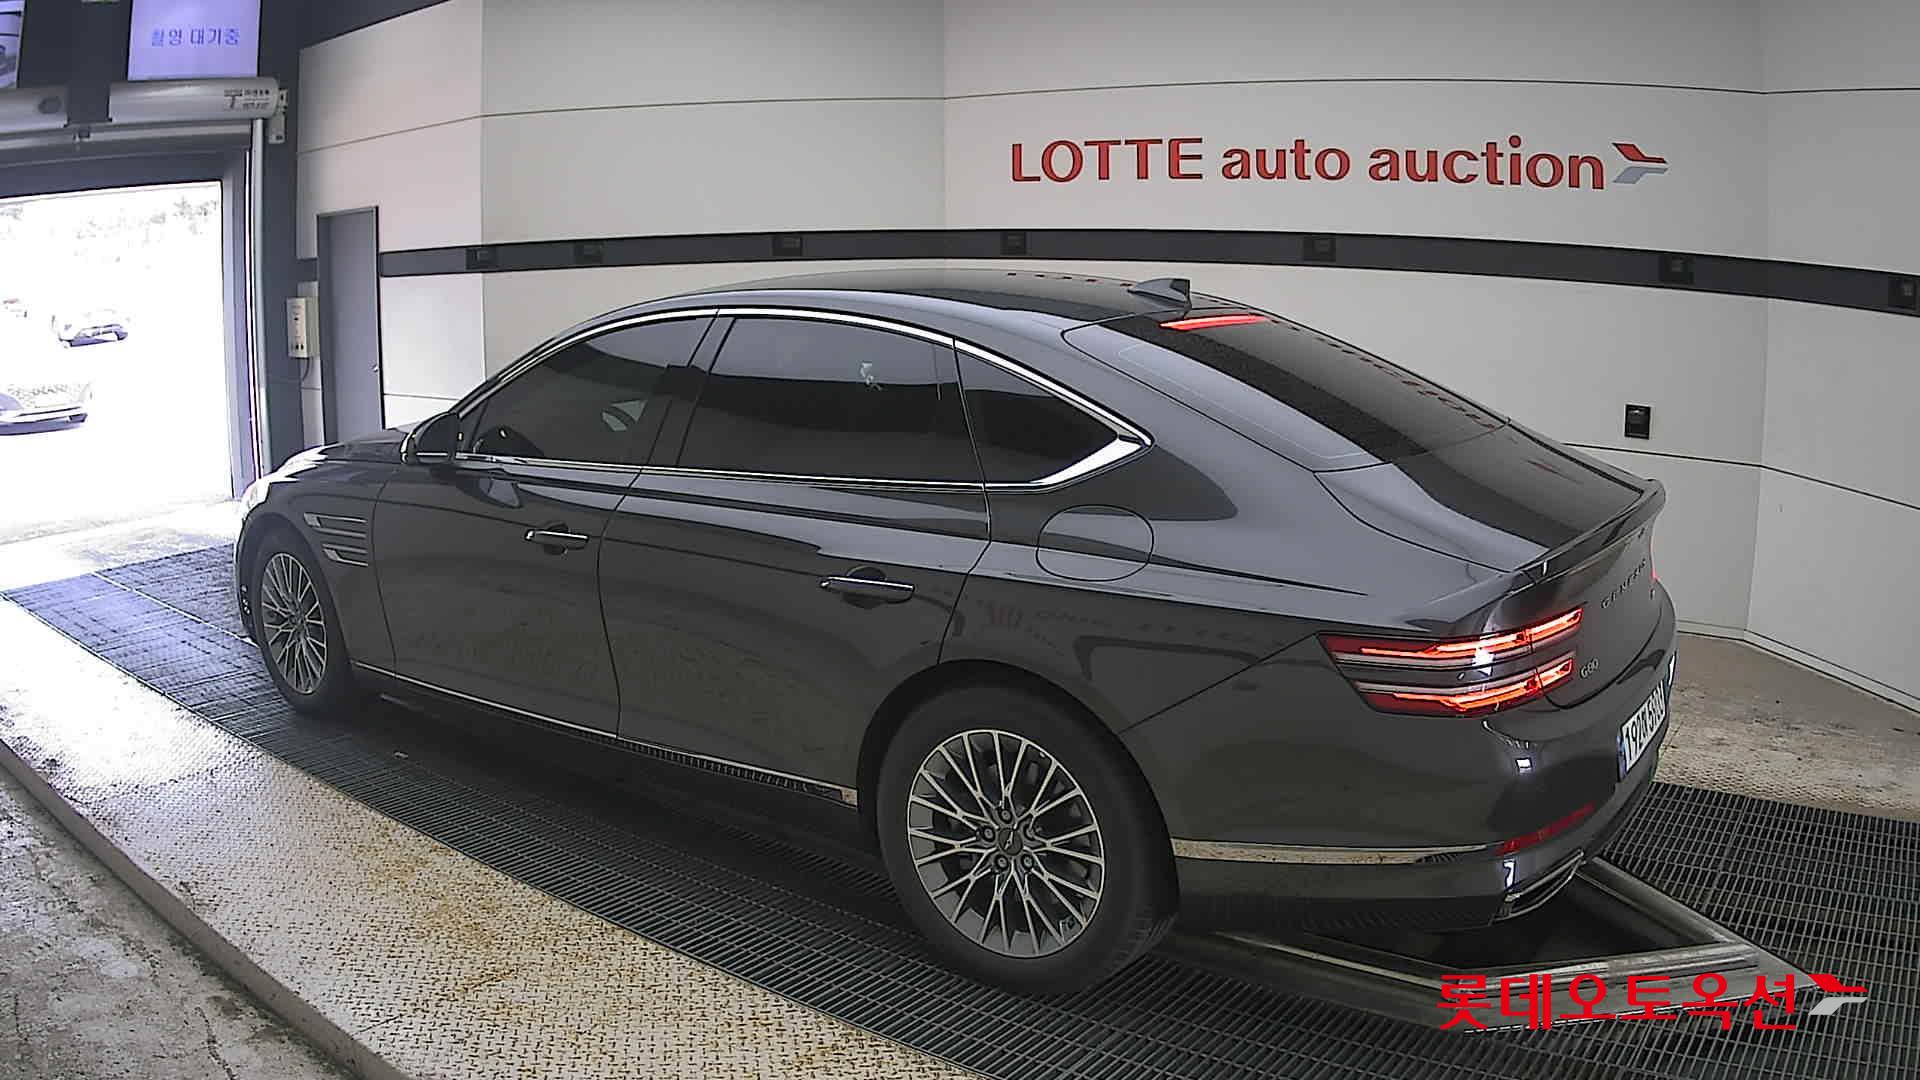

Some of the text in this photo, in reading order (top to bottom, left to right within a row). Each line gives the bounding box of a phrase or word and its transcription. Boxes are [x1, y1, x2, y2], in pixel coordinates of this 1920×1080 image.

[189, 26, 240, 47] 대기중
[1011, 136, 1605, 189] LOTTE auto auction
[1579, 657, 1600, 679] G80
